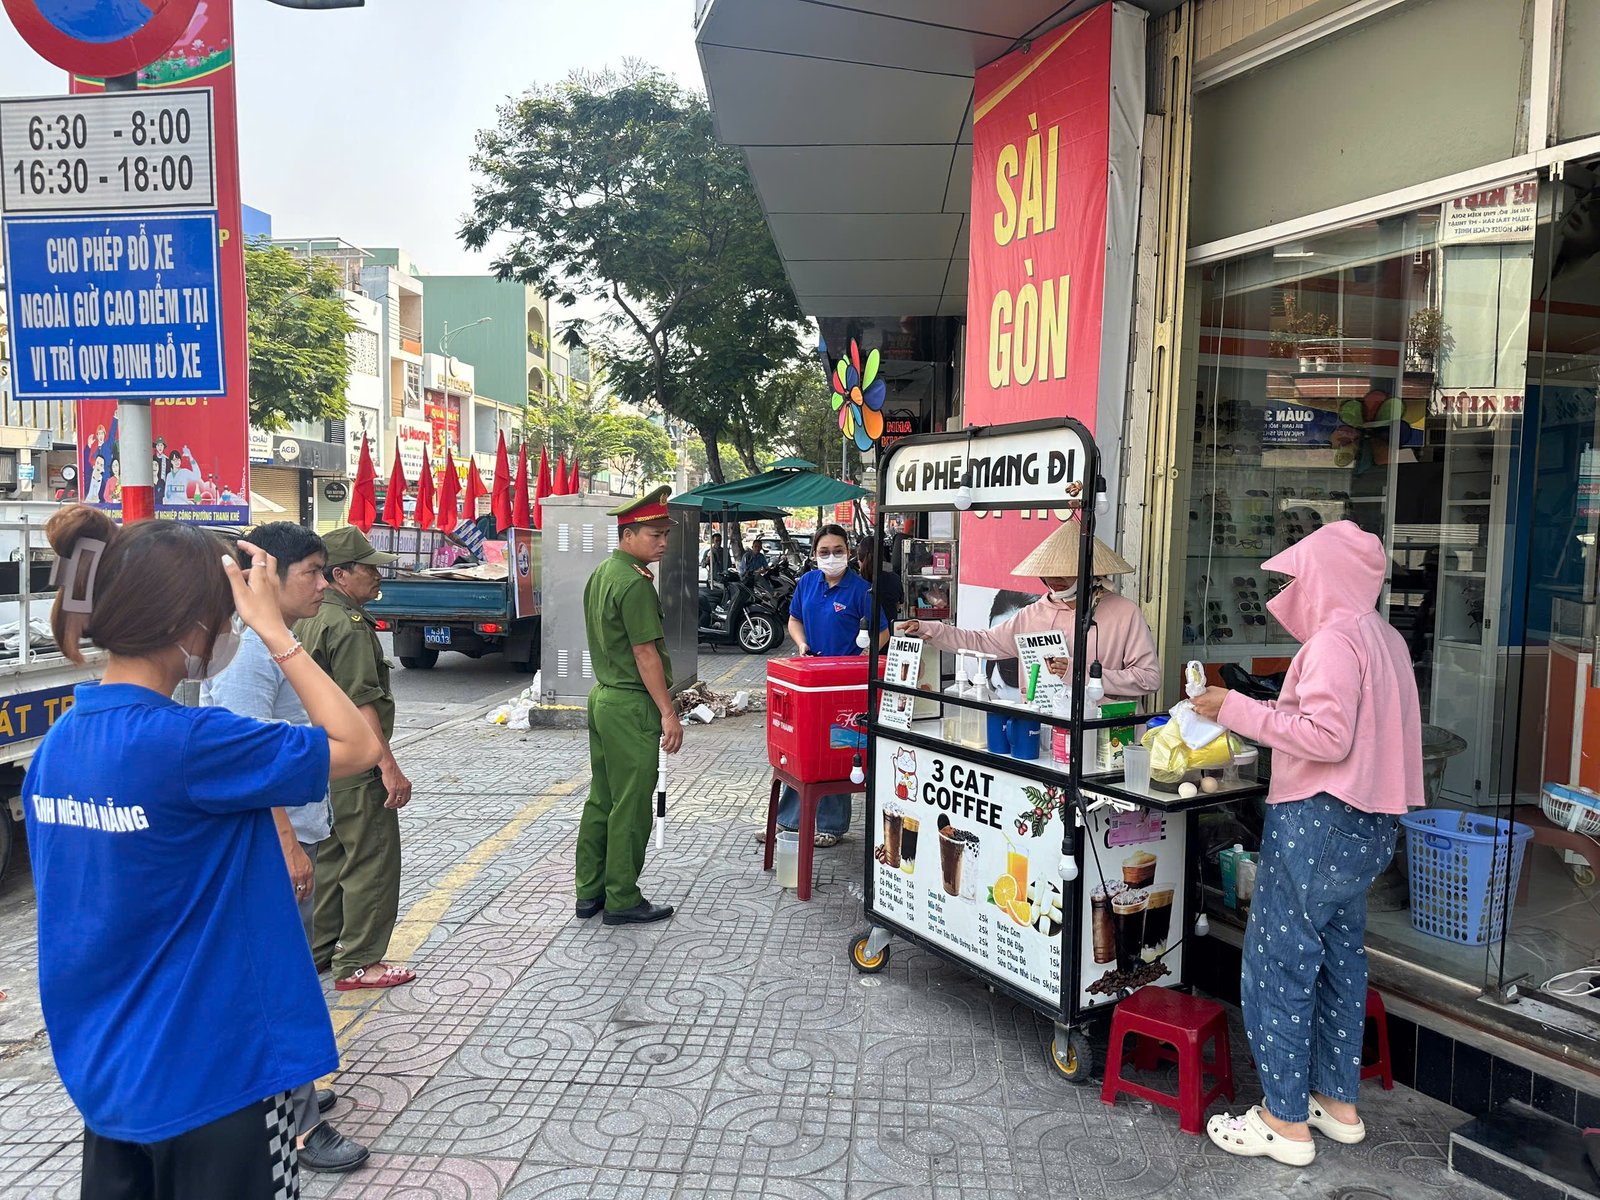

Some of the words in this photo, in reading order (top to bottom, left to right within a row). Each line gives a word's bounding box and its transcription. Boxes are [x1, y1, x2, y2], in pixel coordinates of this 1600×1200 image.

[29, 114, 87, 150] 6:30
[132, 108, 190, 146] 8:00
[14, 158, 88, 194] 16:30
[118, 155, 193, 192] 18:00
[994, 112, 1060, 246] SÀI
[47, 237, 78, 273] CHO
[83, 229, 122, 272] PHÉP
[128, 224, 149, 270] ĐỖ
[154, 234, 174, 270] XE
[20, 285, 70, 328] NGOÀI
[74, 283, 99, 327] GIỜ
[104, 290, 134, 326] CAO
[139, 273, 179, 324] ĐIỂM
[183, 288, 208, 330] TẠI
[988, 258, 1070, 390] GÒN
[30, 346, 47, 387] VỊ
[50, 339, 75, 380] TRÍ
[79, 345, 108, 384] QUY
[113, 344, 151, 386] ĐỊNH
[156, 332, 177, 378] ĐỖ
[181, 343, 202, 378] XE
[969, 453, 1039, 488] MANG
[1048, 449, 1075, 485] ĐI
[896, 641, 920, 653] MENU
[1027, 634, 1061, 647] MENU
[932, 760, 944, 782] 3
[950, 765, 994, 798] CAT
[83, 798, 100, 829] ĐÀ
[923, 782, 1002, 830] COFFEE
